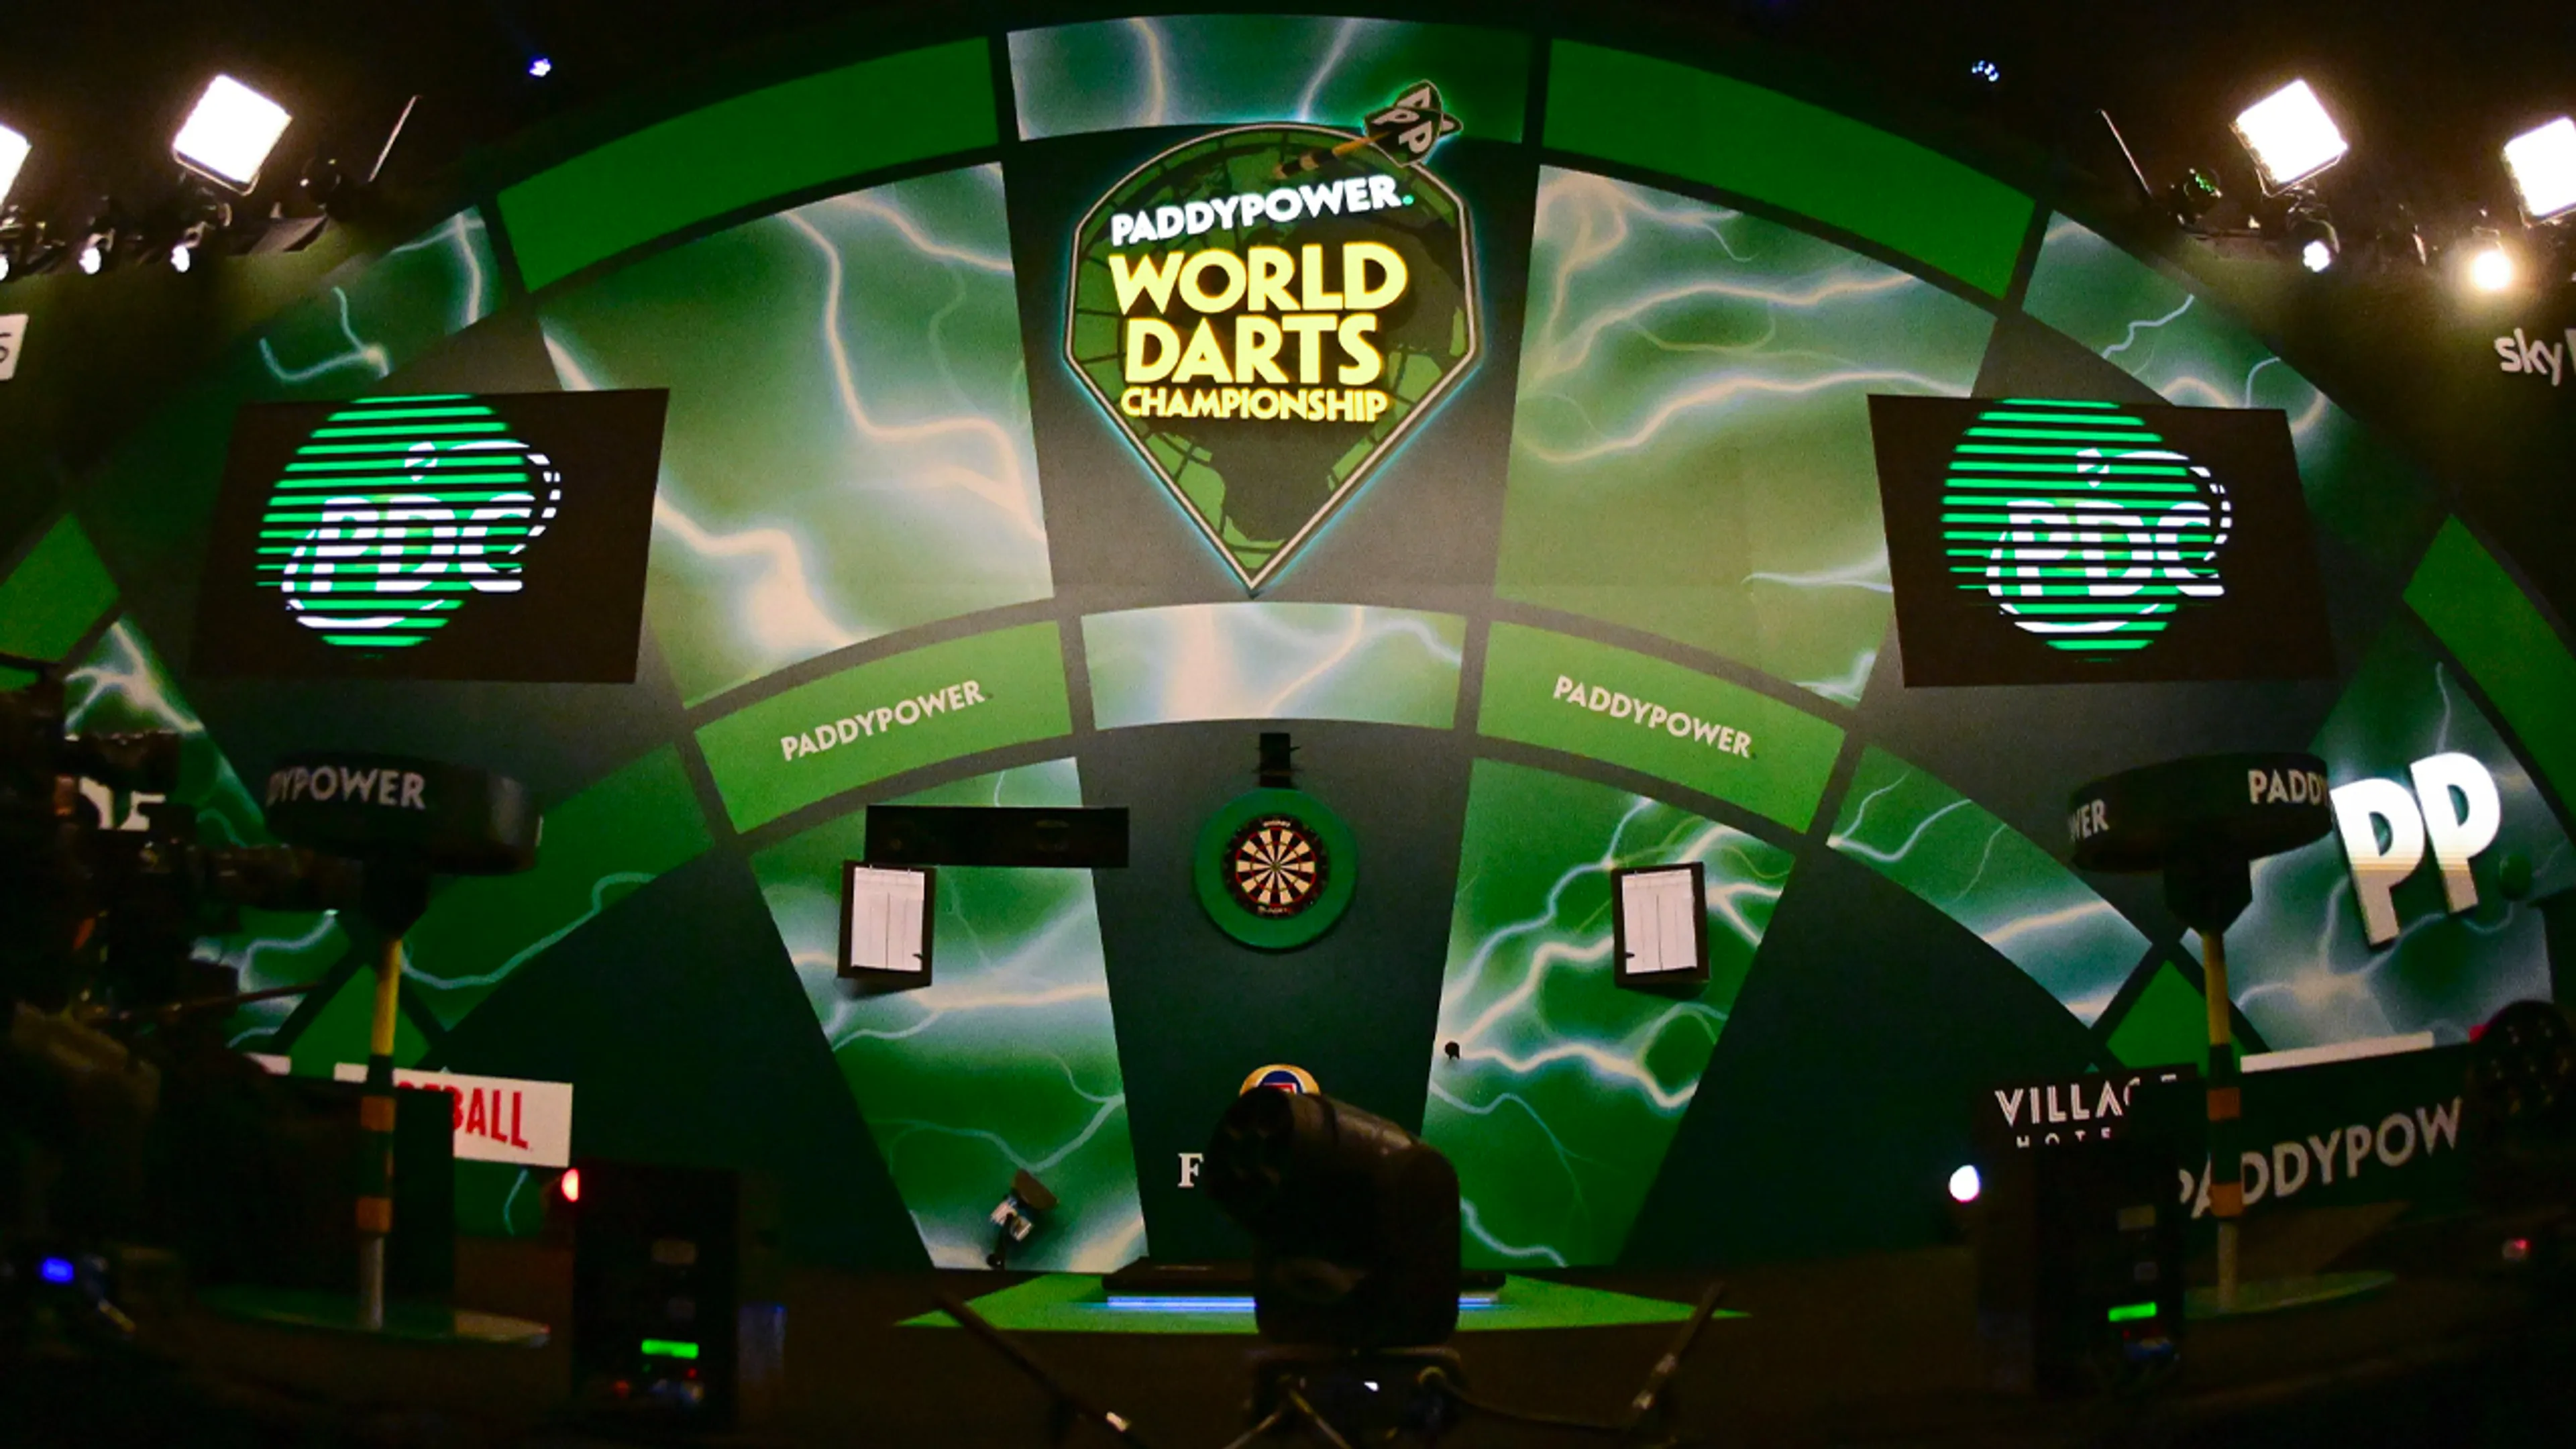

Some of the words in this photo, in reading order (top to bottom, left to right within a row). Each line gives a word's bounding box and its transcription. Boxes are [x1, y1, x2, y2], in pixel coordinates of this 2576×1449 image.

[1108, 241, 1409, 315] WORLD
[1124, 313, 1383, 385] DARTS
[2493, 327, 2563, 387] sky
[1120, 387, 1388, 422] CHAMPIONSHIP
